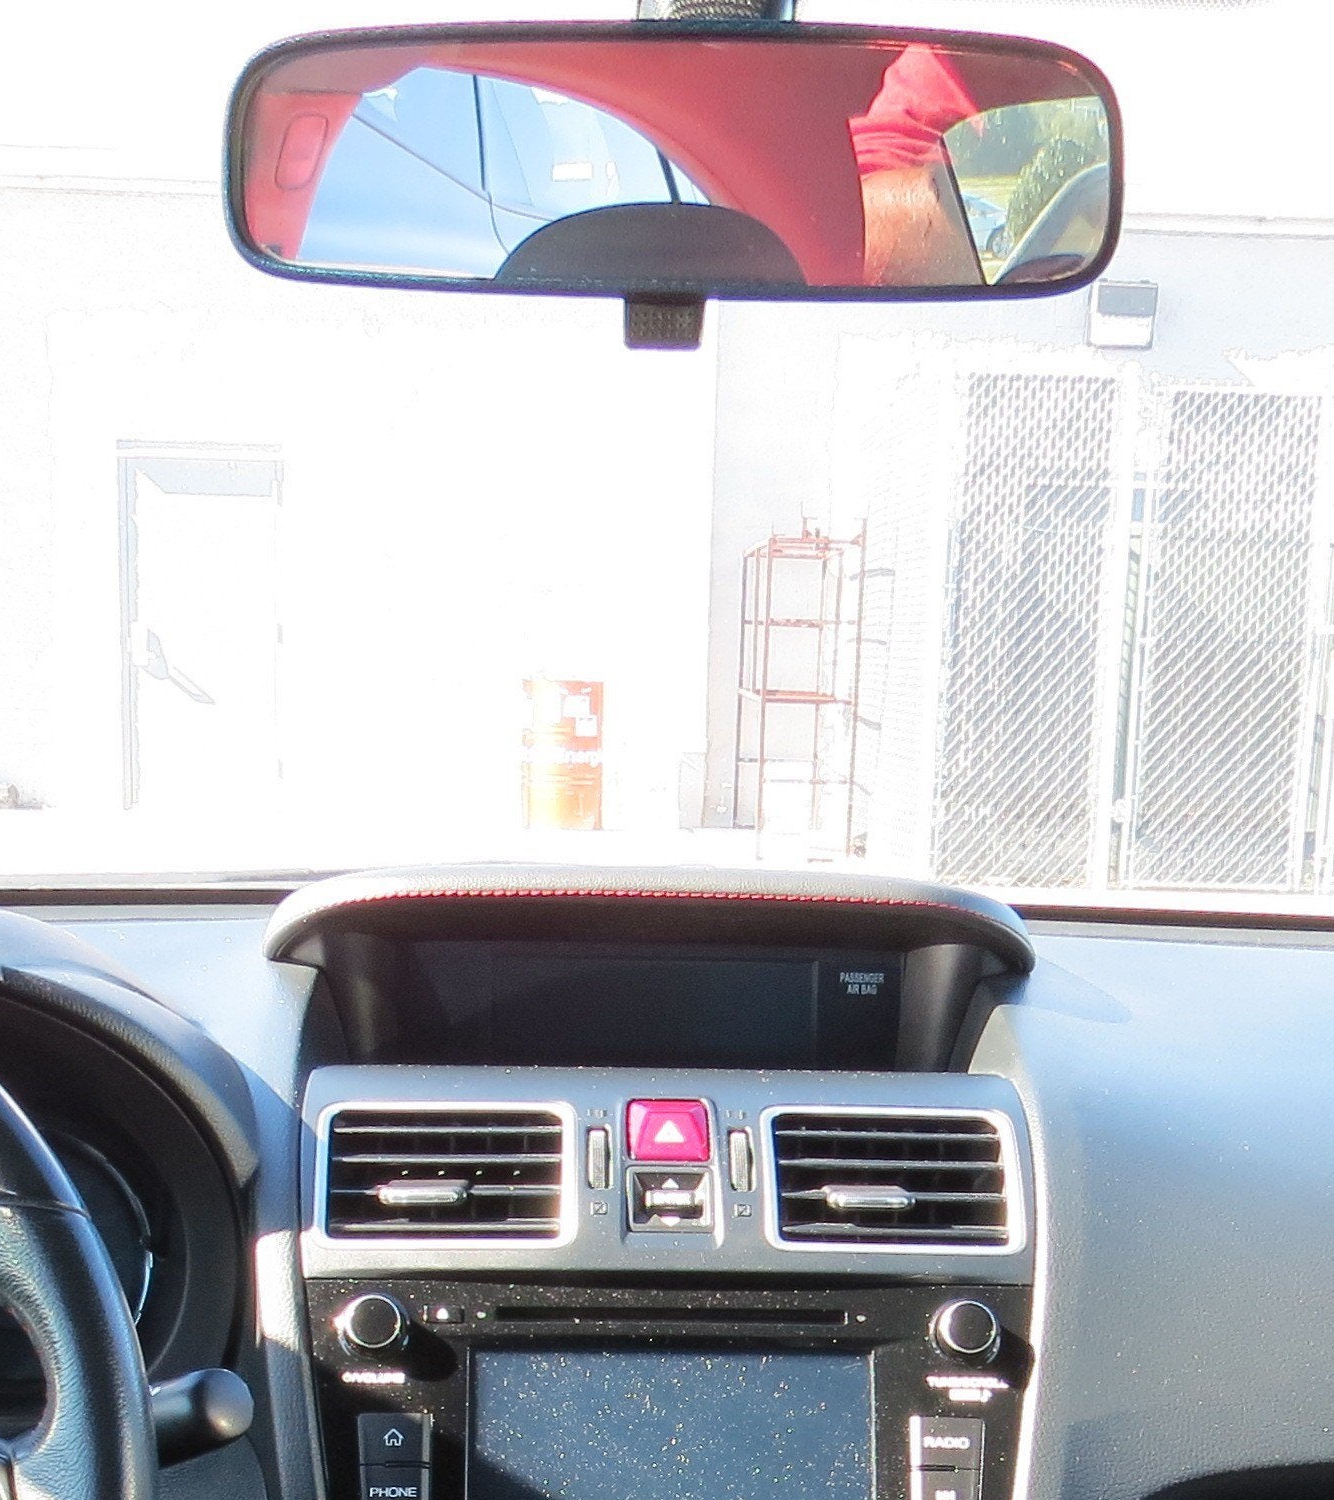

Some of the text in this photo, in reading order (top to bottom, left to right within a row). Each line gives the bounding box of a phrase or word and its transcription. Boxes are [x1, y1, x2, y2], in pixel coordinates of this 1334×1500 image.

[839, 972, 885, 984] PASSENGER
[846, 984, 878, 995] AIR BAG
[923, 1436, 971, 1450] RADIO
[369, 1486, 418, 1498] PHONE
